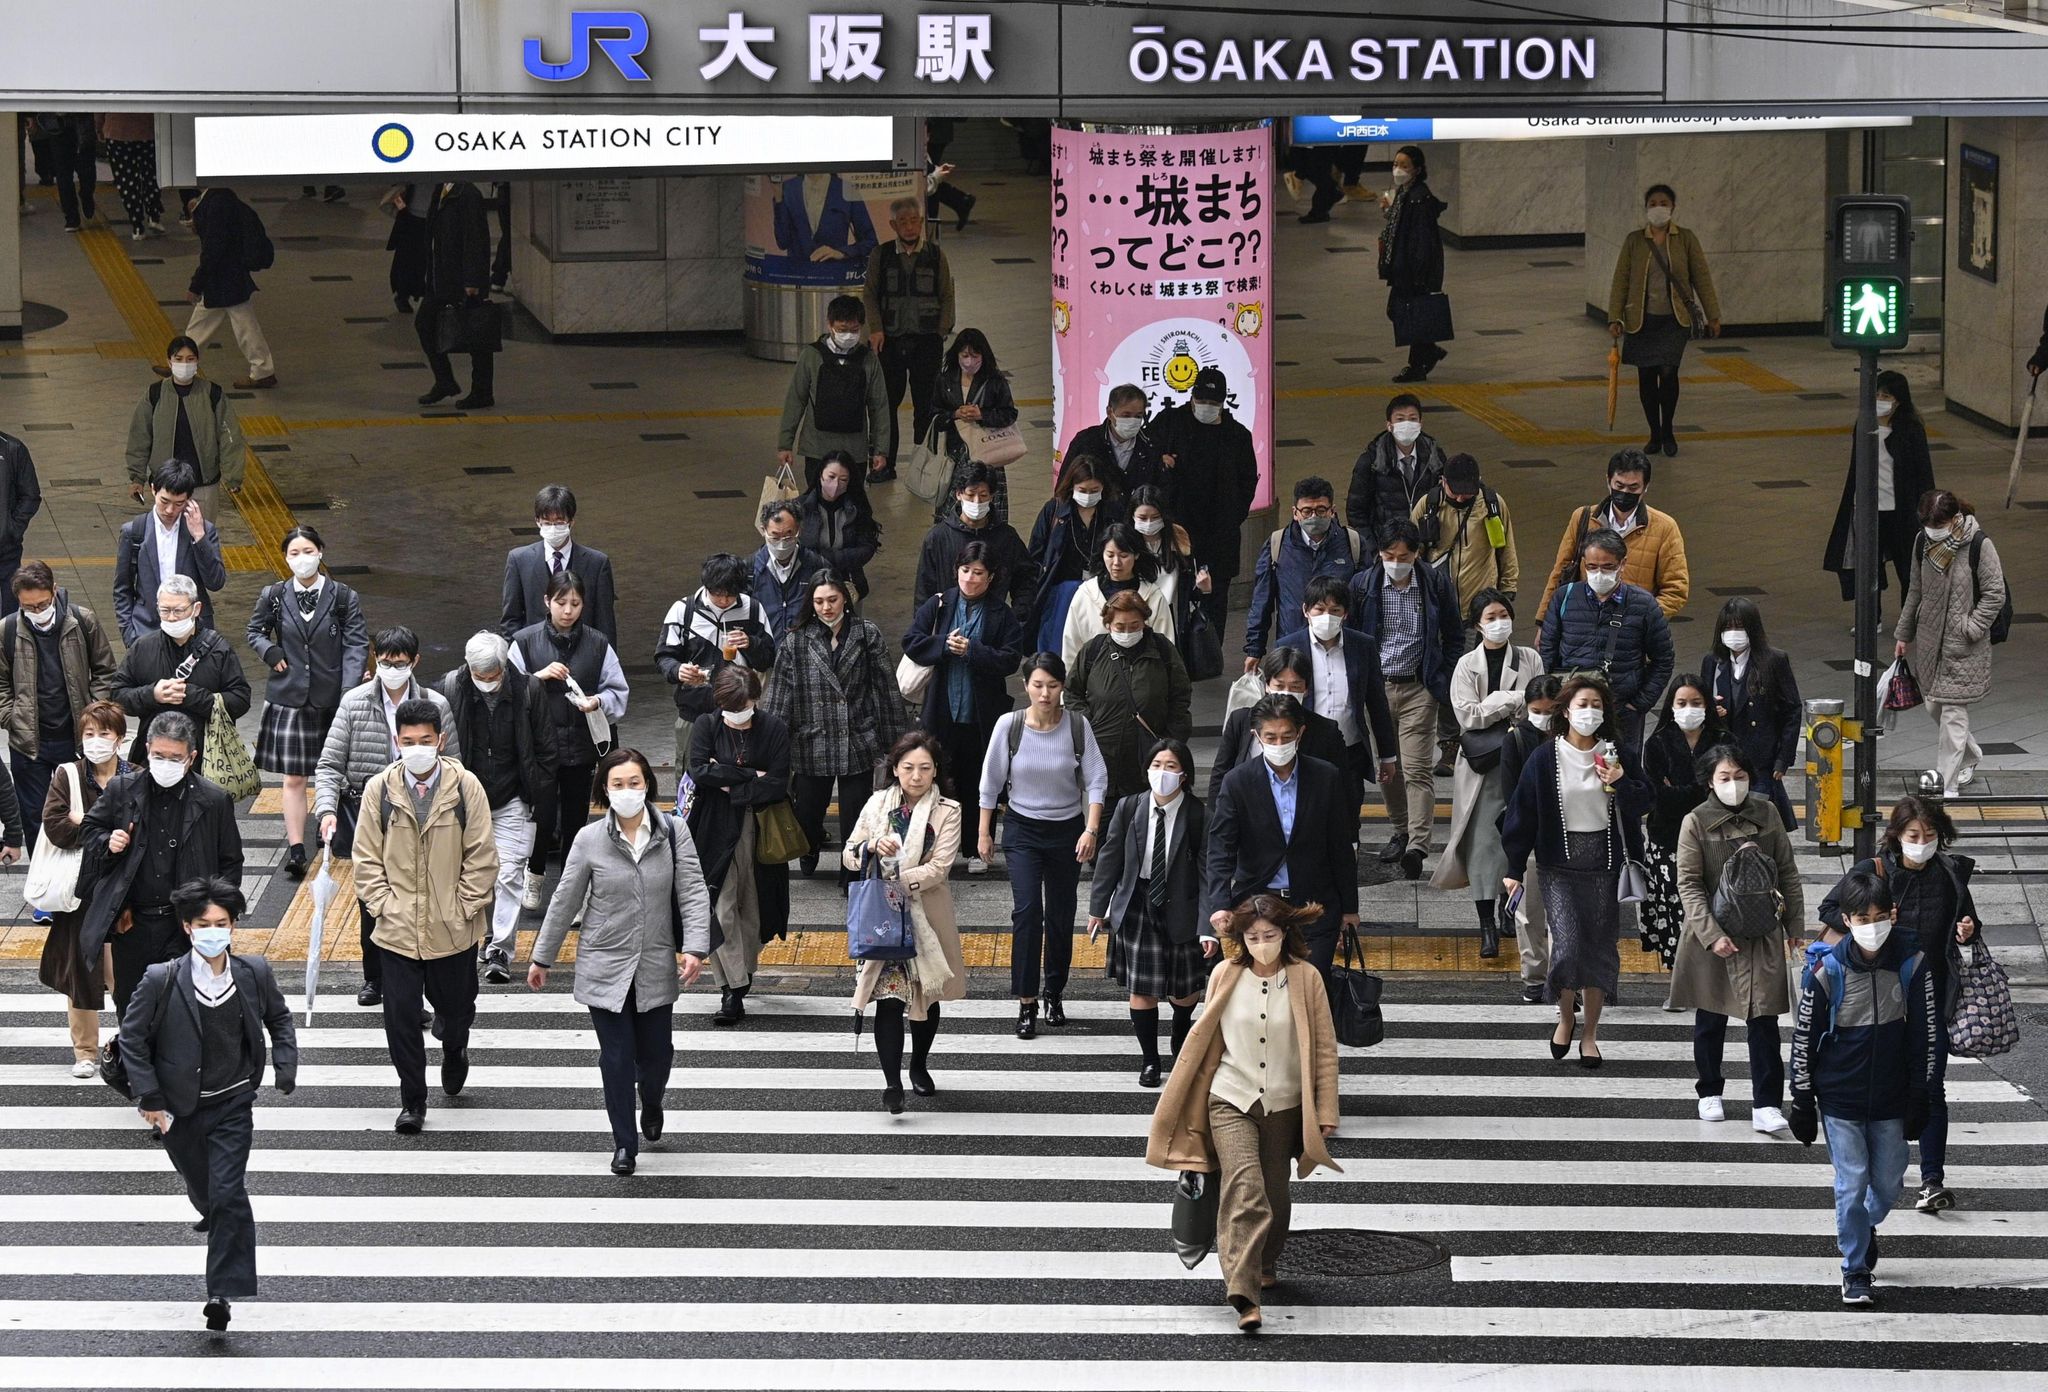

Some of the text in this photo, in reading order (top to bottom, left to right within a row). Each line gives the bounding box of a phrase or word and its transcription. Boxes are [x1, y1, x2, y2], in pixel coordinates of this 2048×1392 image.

[523, 11, 995, 84] JR 大阪駅
[1349, 37, 1596, 82] STATION
[434, 125, 723, 152] OSAKA STATION CITY
[1337, 125, 1389, 138] JR西日本
[1088, 145, 1262, 168] 城まち祭を開催します!
[1152, 172, 1168, 181] しろ
[1090, 229, 1262, 272] ってどこ??
[1089, 280, 1153, 297] くわしくは
[1159, 280, 1219, 297] 城まち祭
[1160, 330, 1202, 344] SHIROMACHI
[981, 431, 1015, 443] COACH
[219, 775, 236, 787] OF
